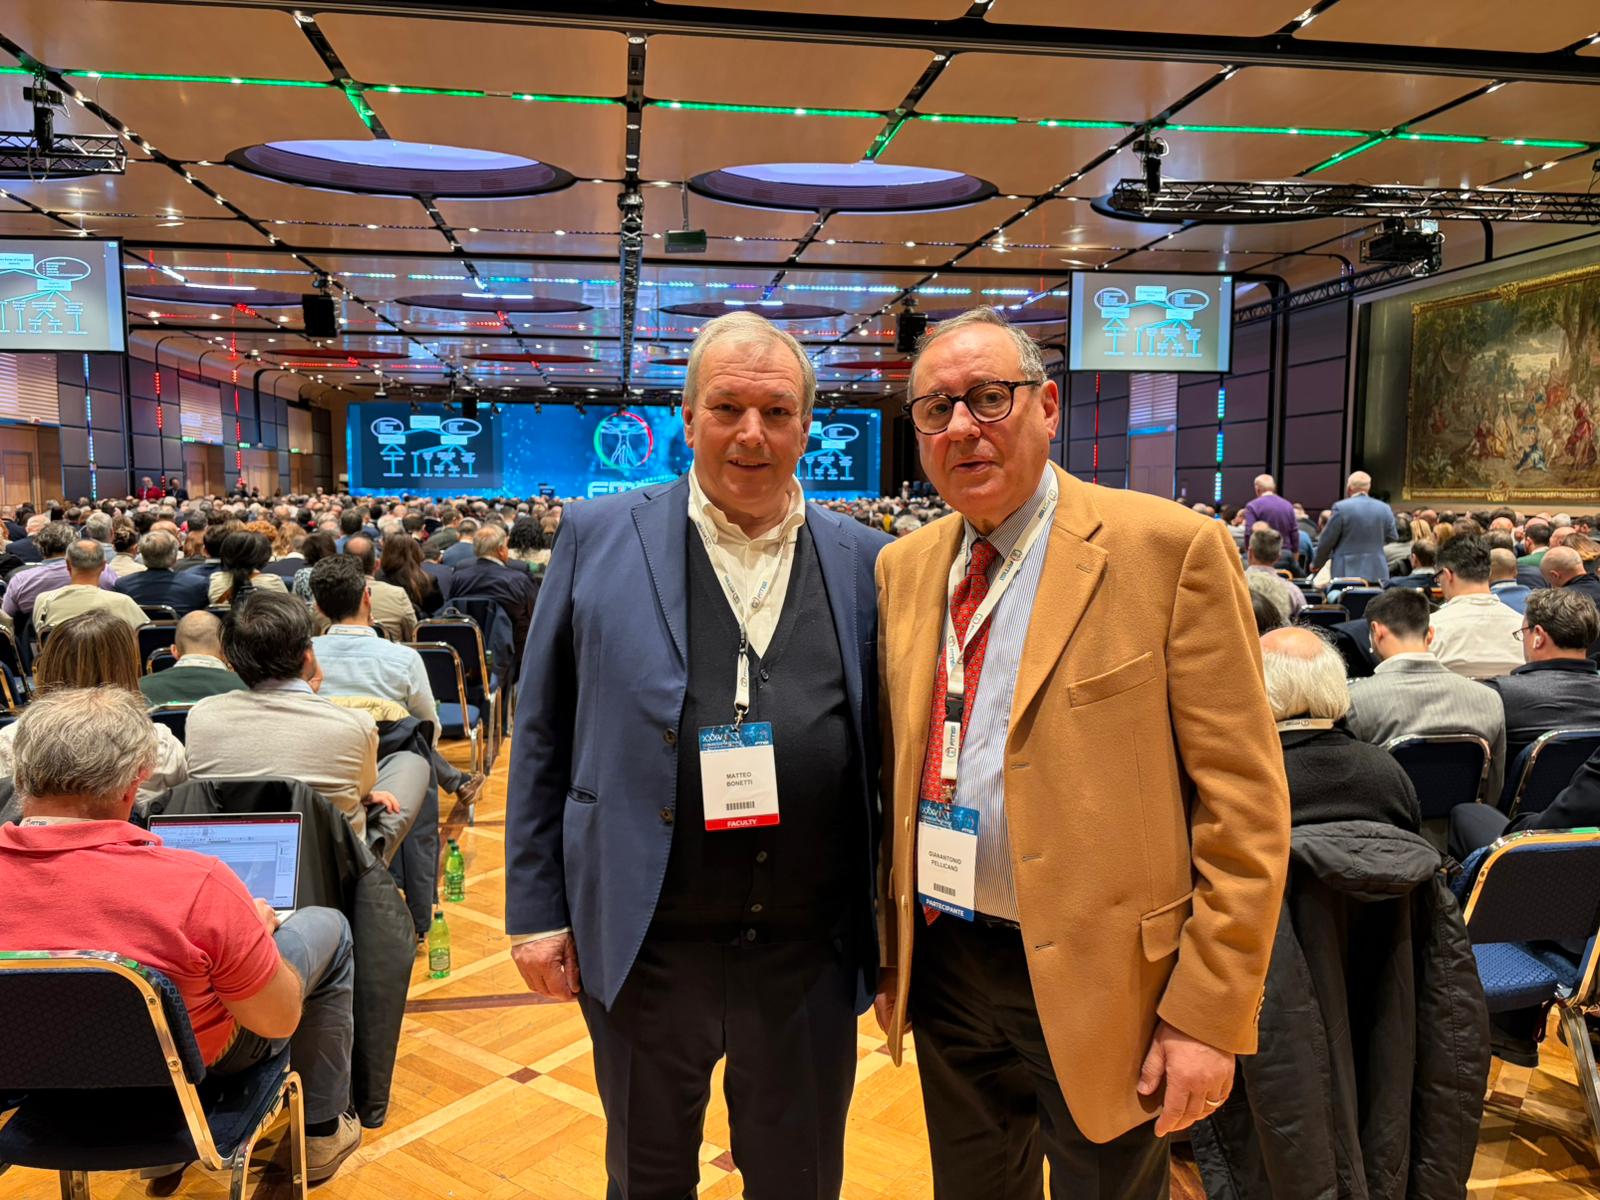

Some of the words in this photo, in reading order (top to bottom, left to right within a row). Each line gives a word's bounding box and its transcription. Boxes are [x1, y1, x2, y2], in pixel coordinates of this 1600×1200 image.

[726, 771, 752, 779] MATTEO
[726, 779, 753, 787] BONETTI
[727, 818, 758, 828] FACULTY
[926, 898, 965, 917] PARTECIPANTE
